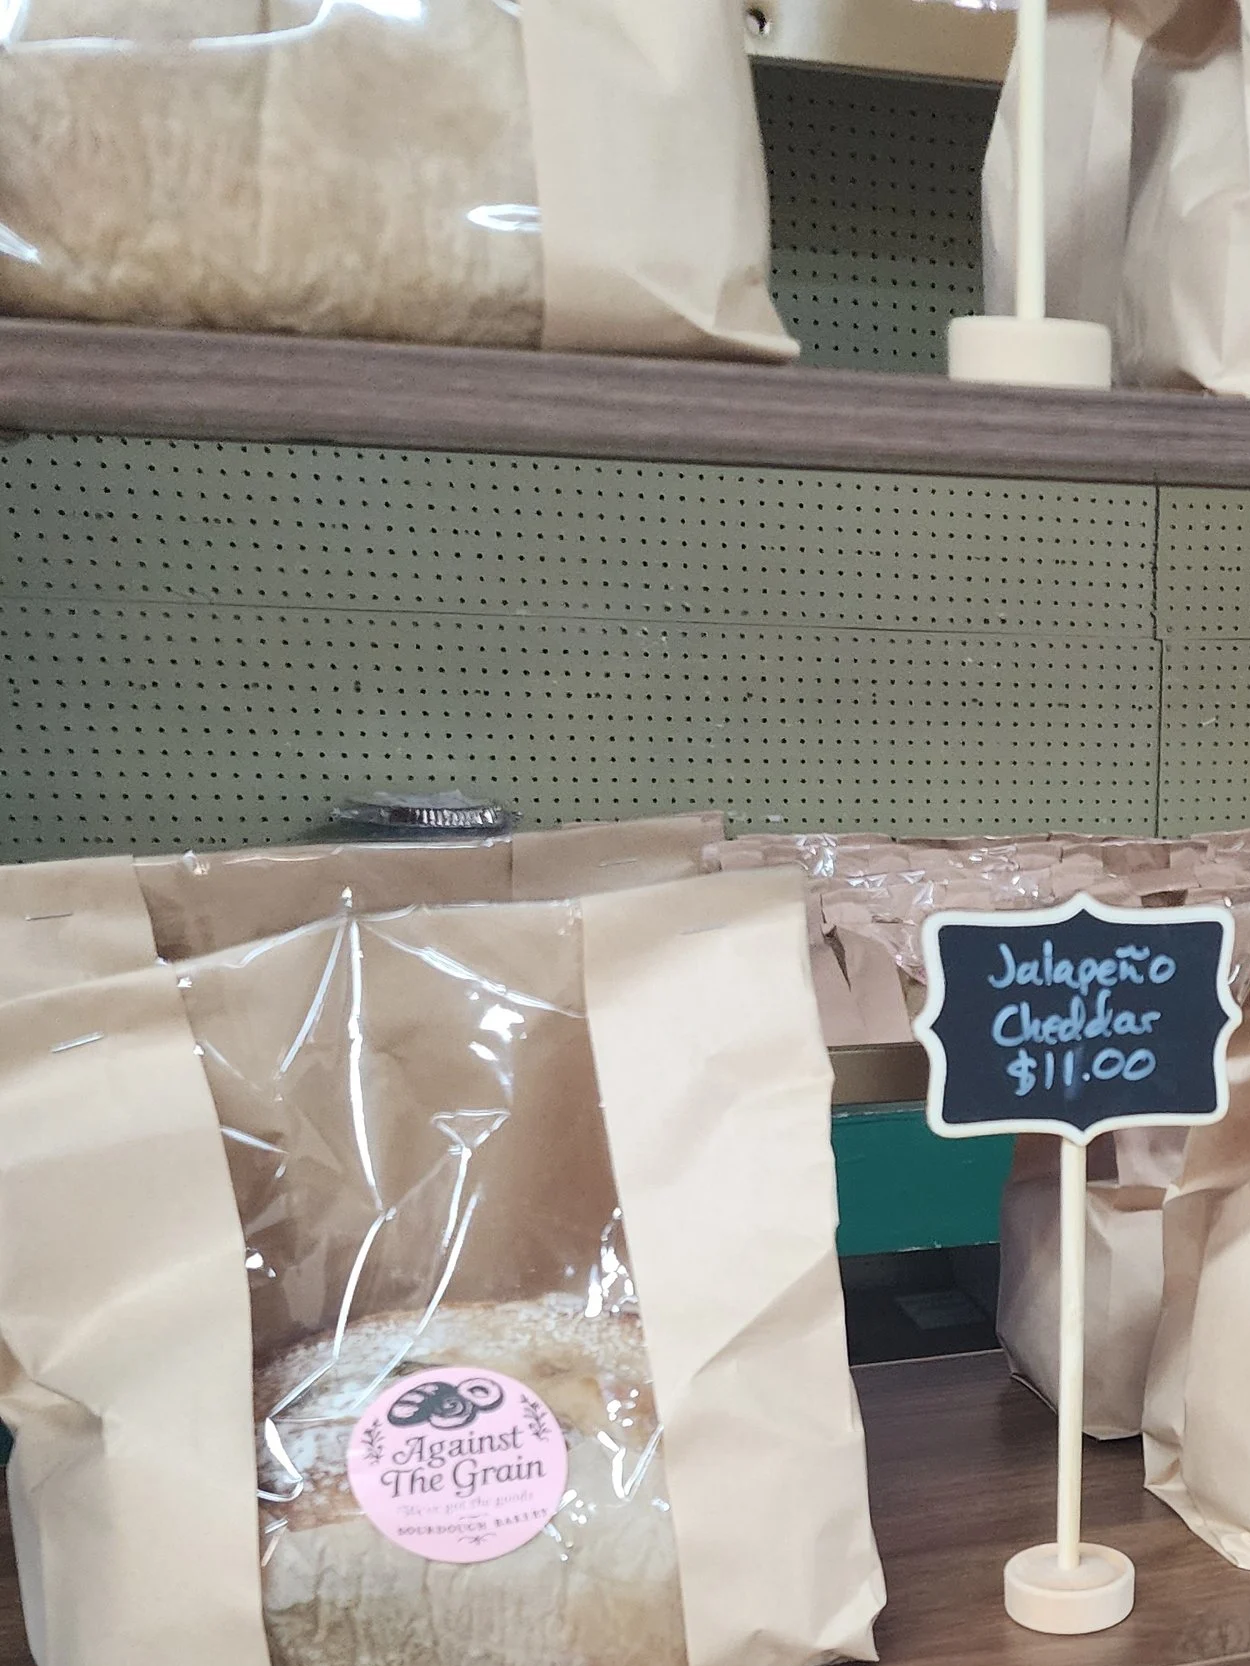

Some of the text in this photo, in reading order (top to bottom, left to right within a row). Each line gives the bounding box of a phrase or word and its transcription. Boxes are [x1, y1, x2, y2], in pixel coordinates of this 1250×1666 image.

[988, 939, 1177, 996] Jalapeño
[992, 989, 1162, 1047] Cheddar
[1006, 1048, 1156, 1097] $11.00
[392, 1426, 524, 1468] Against
[380, 1455, 546, 1499] The Grain
